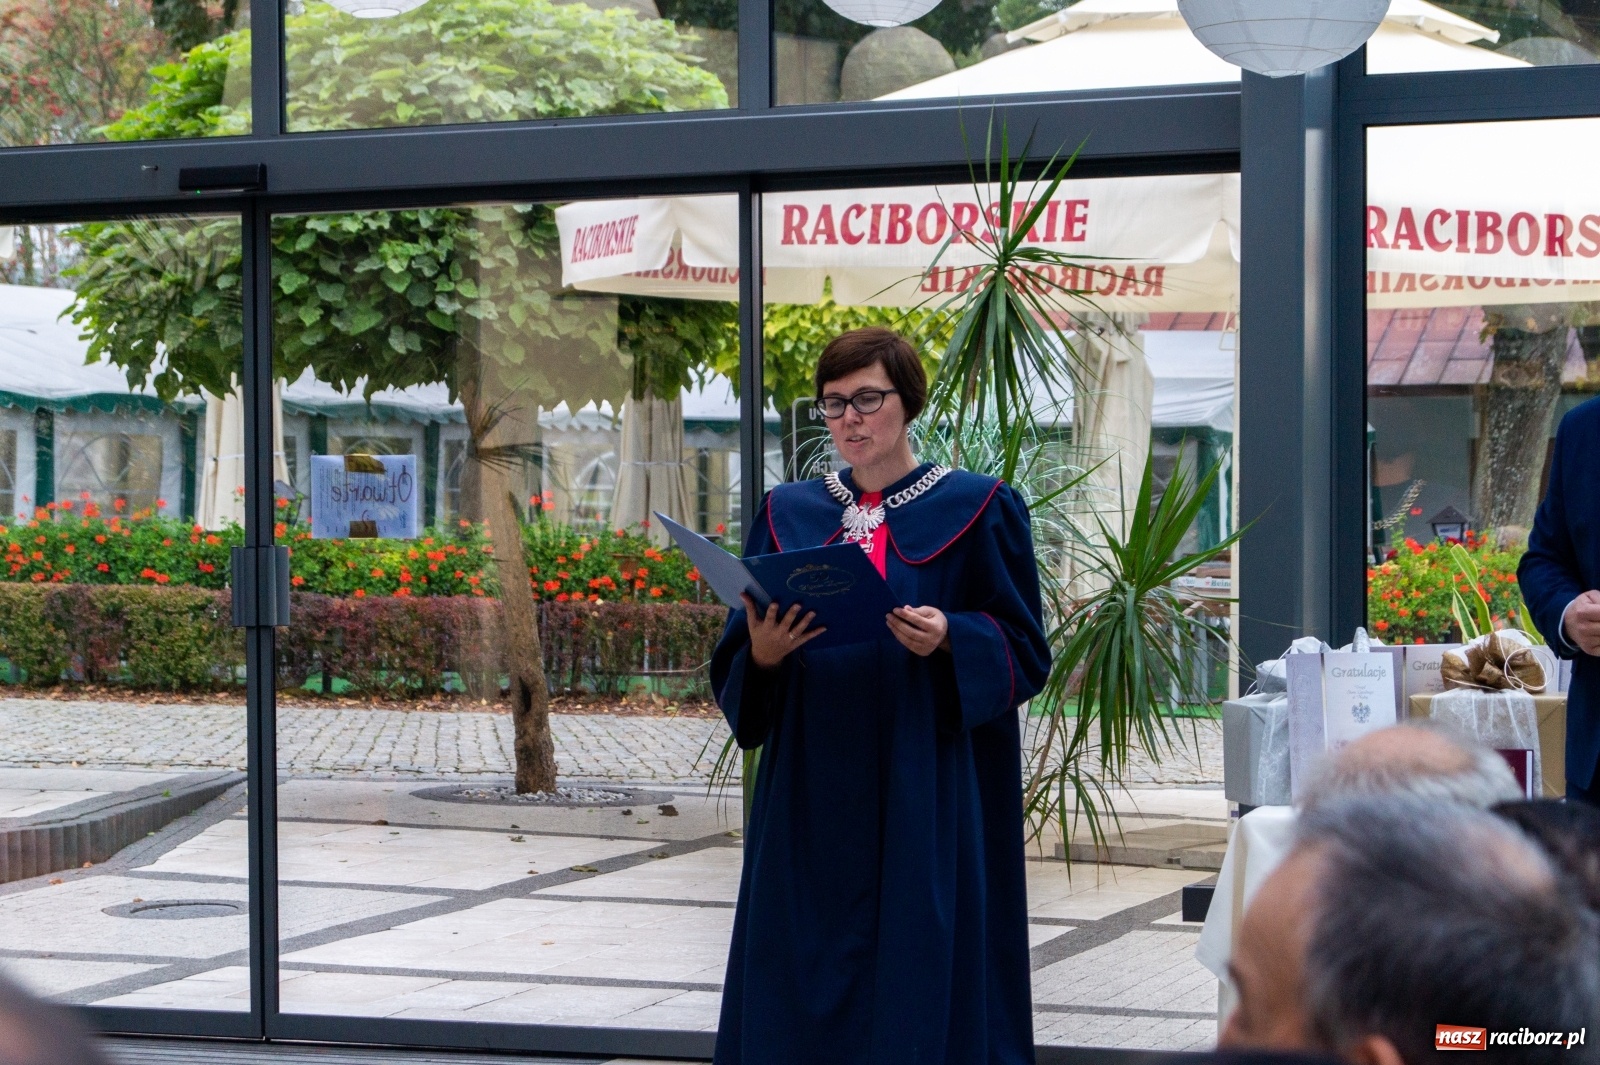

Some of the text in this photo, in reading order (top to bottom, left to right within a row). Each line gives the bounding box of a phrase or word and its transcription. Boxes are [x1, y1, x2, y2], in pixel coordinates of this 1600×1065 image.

[571, 214, 639, 263] RACIBORSKIE
[781, 199, 1090, 246] RACIBORSKIE
[1331, 663, 1387, 681] Gratulacje
